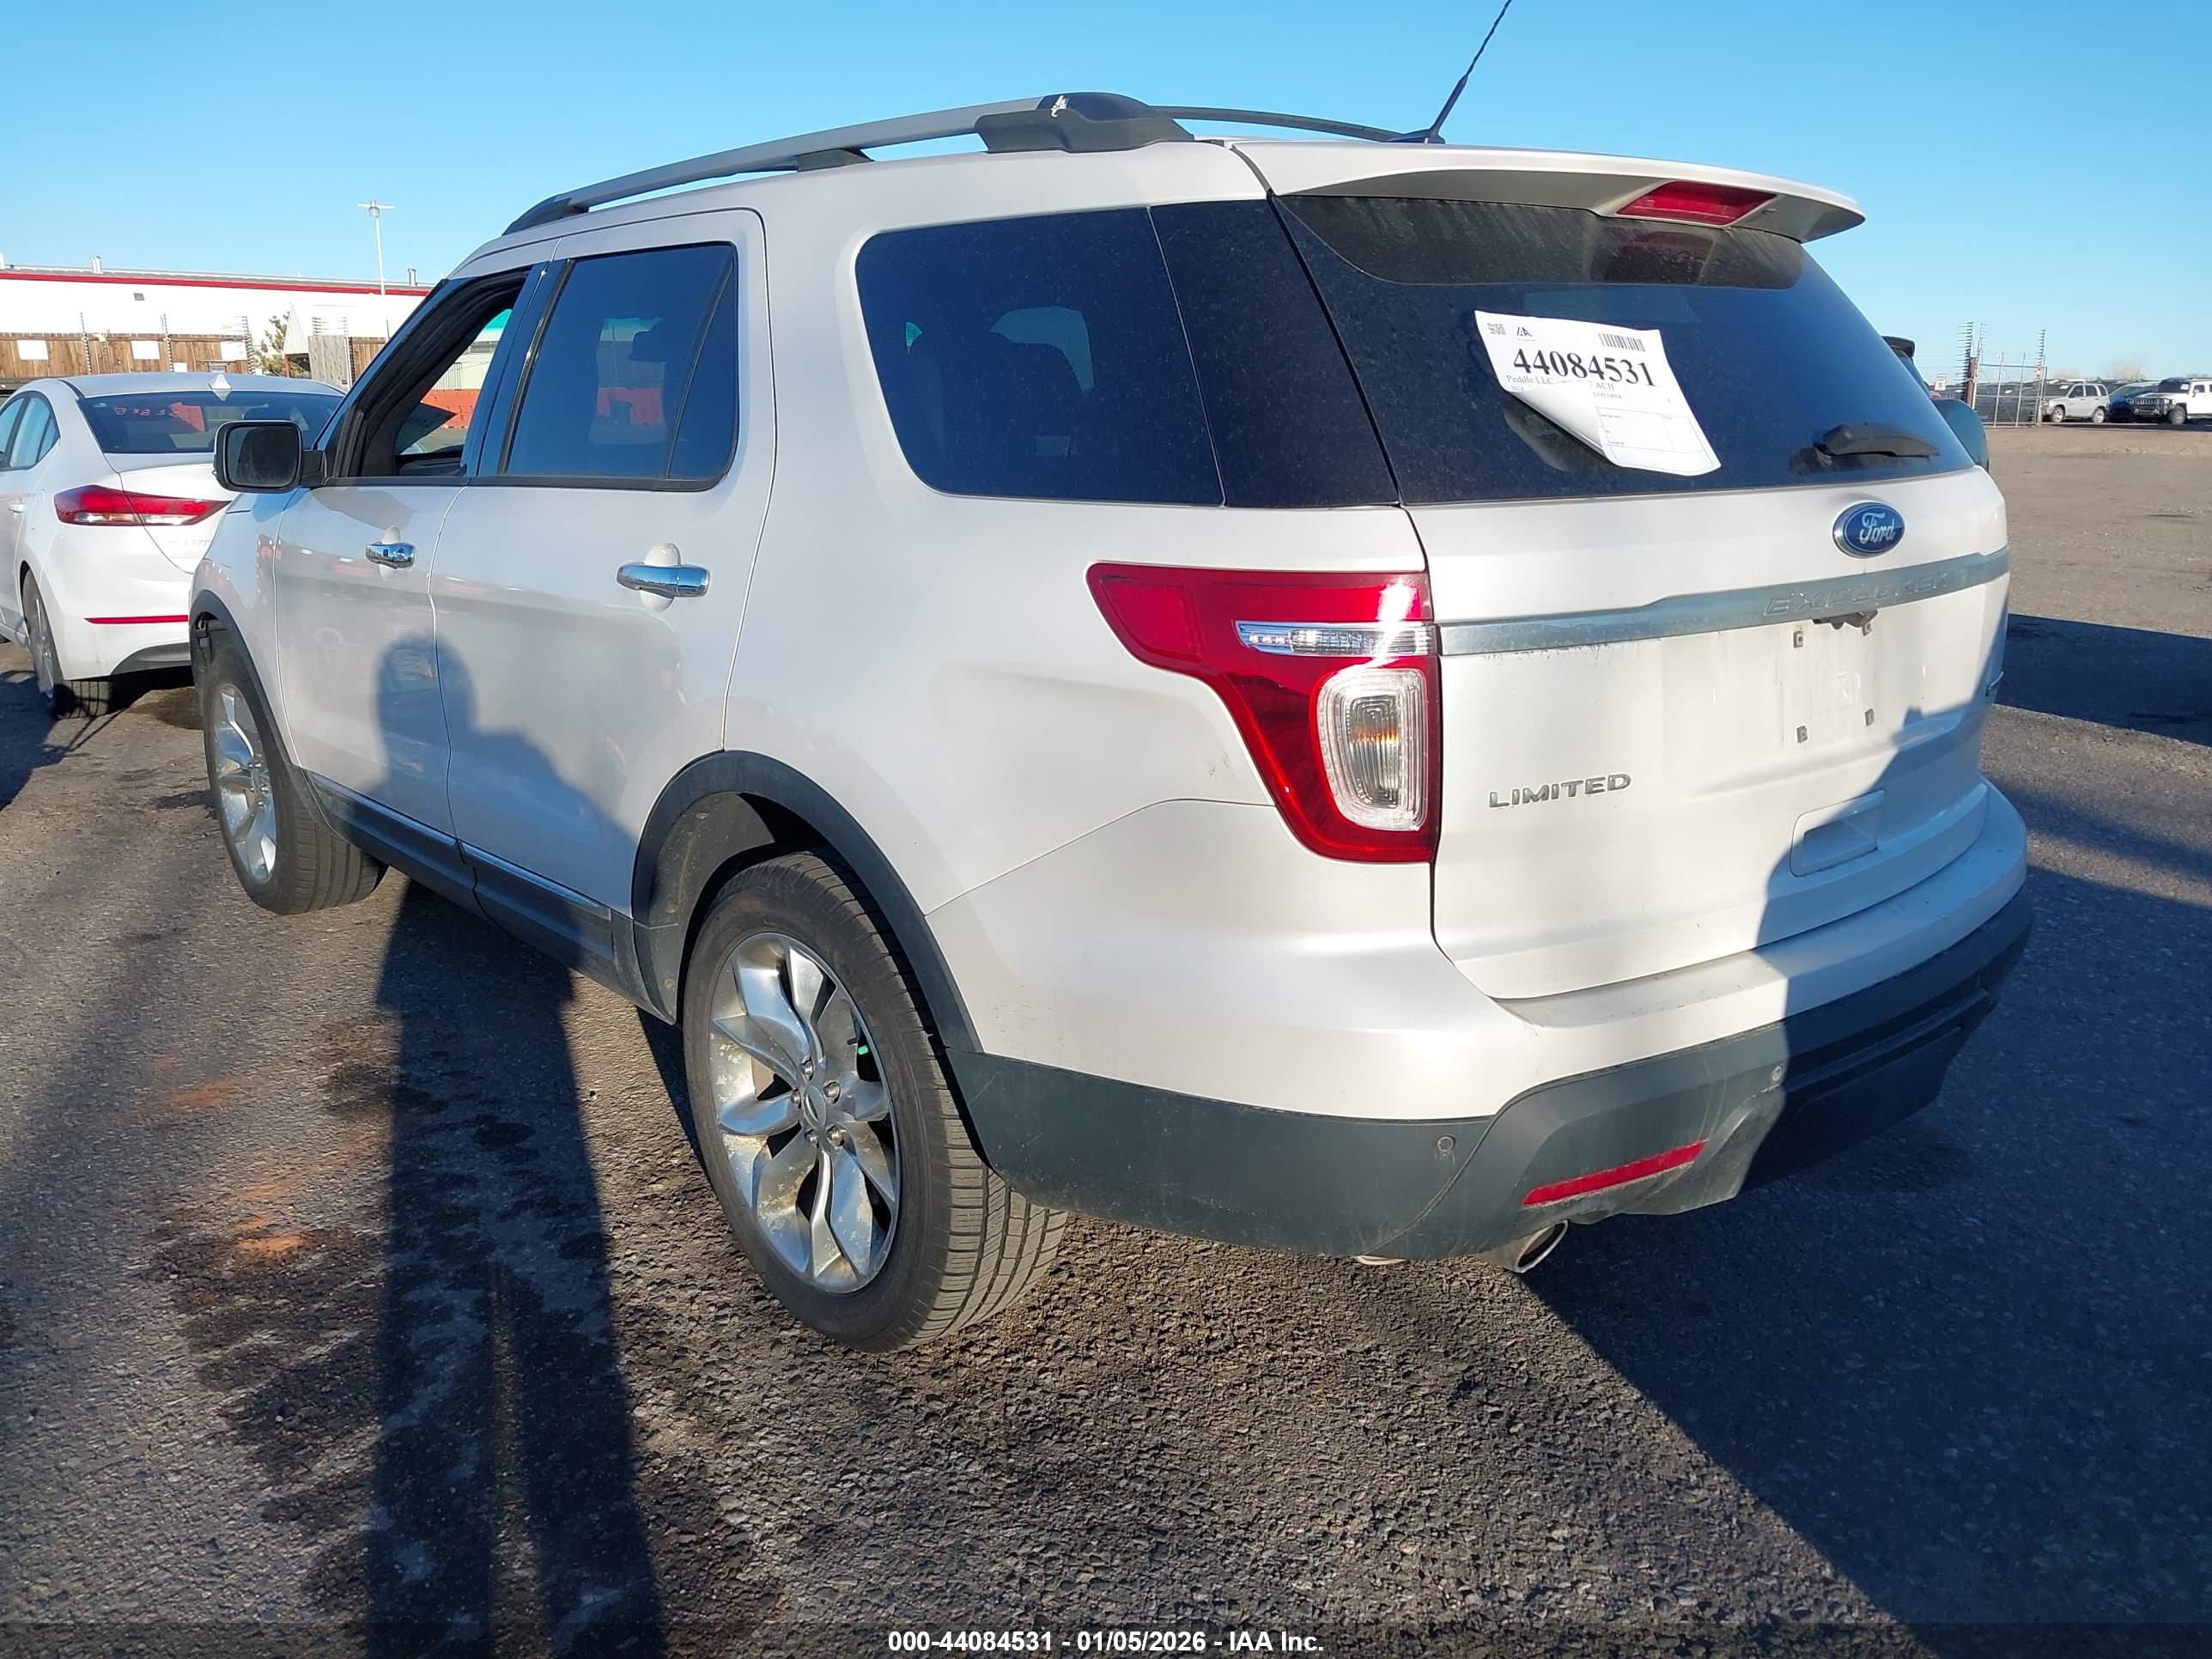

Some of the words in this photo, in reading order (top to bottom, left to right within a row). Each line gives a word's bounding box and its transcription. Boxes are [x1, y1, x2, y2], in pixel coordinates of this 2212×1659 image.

[1506, 374, 1534, 384] Peddle
[1534, 376, 1553, 385] LLC
[1513, 348, 1656, 386] 44084531
[1859, 513, 1896, 544] Ford
[1763, 571, 1948, 617] EXPLORER
[1489, 773, 1632, 808] LIMITED
